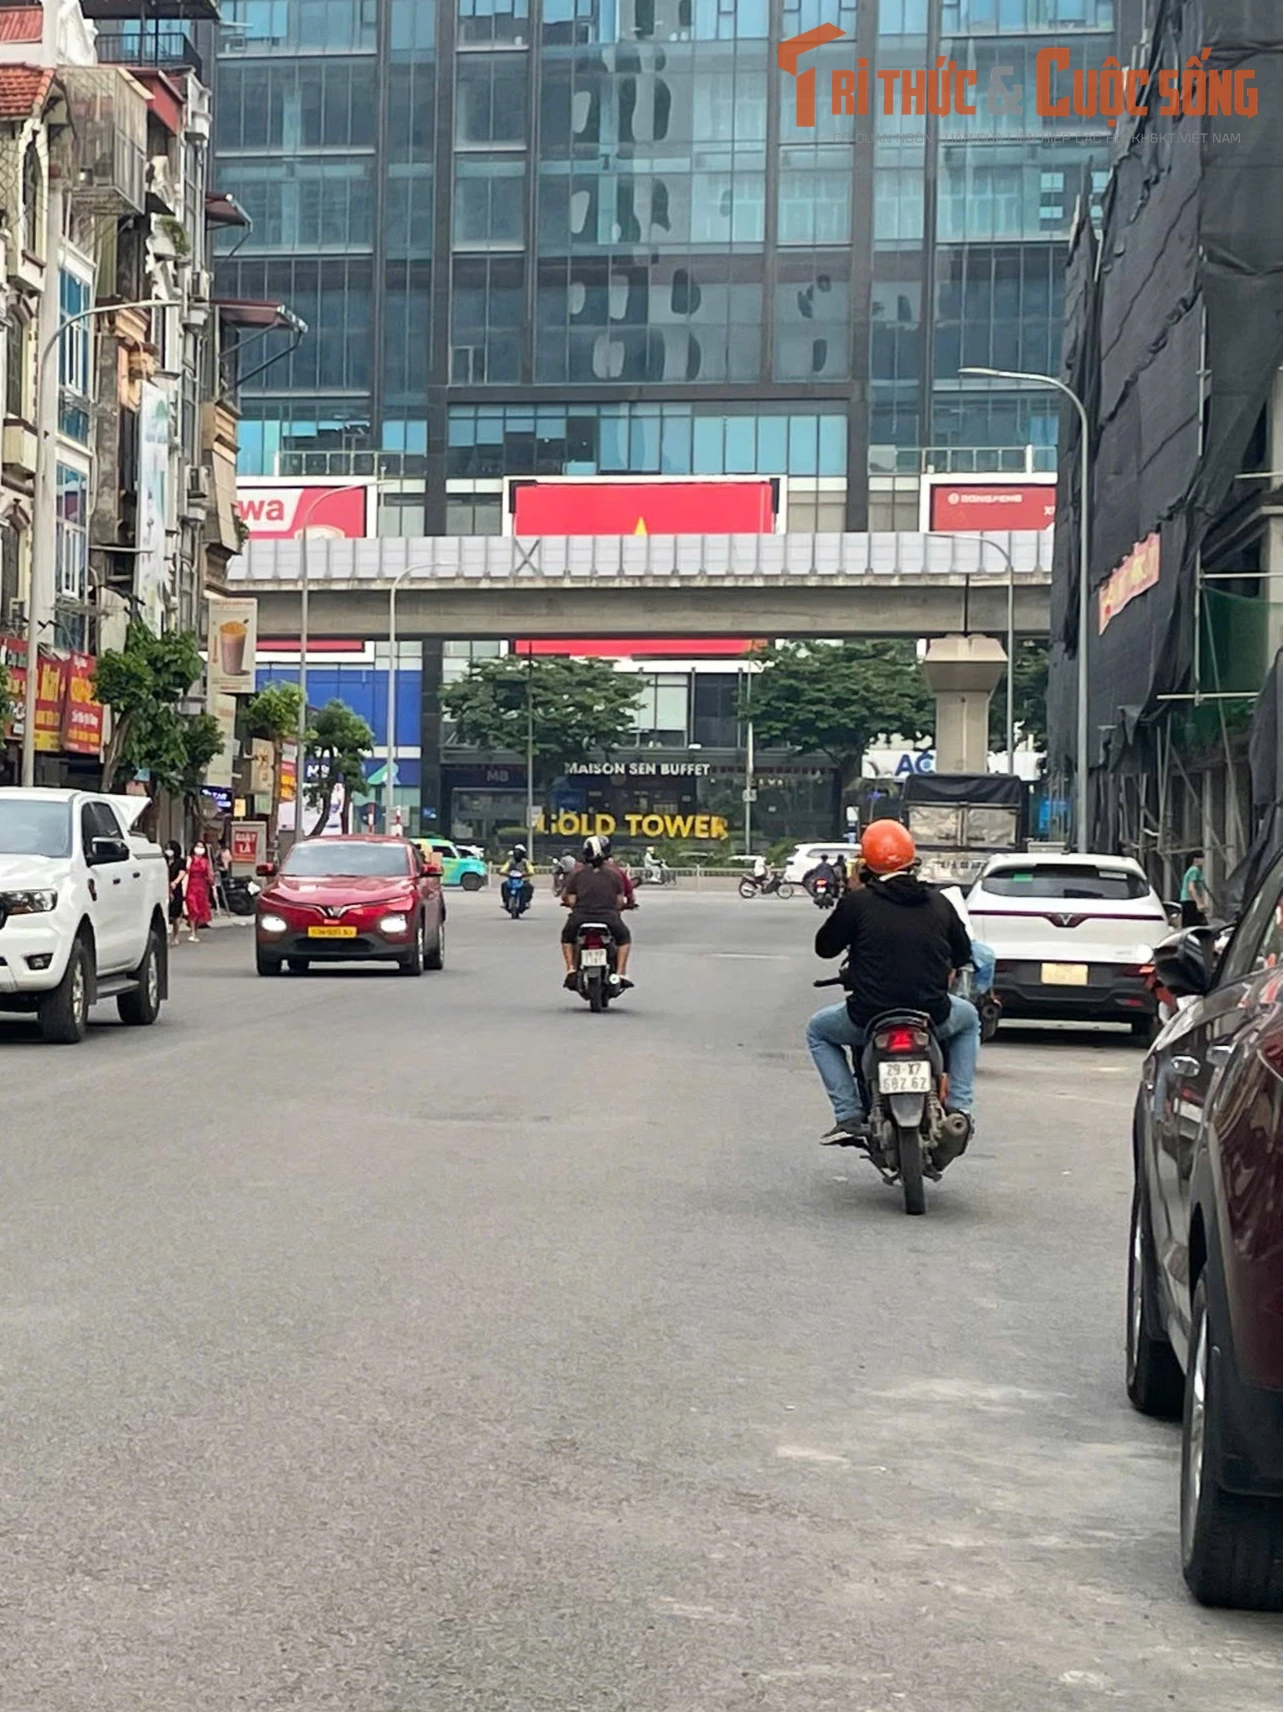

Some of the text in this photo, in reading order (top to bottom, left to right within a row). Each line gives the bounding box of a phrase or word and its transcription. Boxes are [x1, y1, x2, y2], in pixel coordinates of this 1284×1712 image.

[565, 762, 711, 776] MAISON SEN BUFFET
